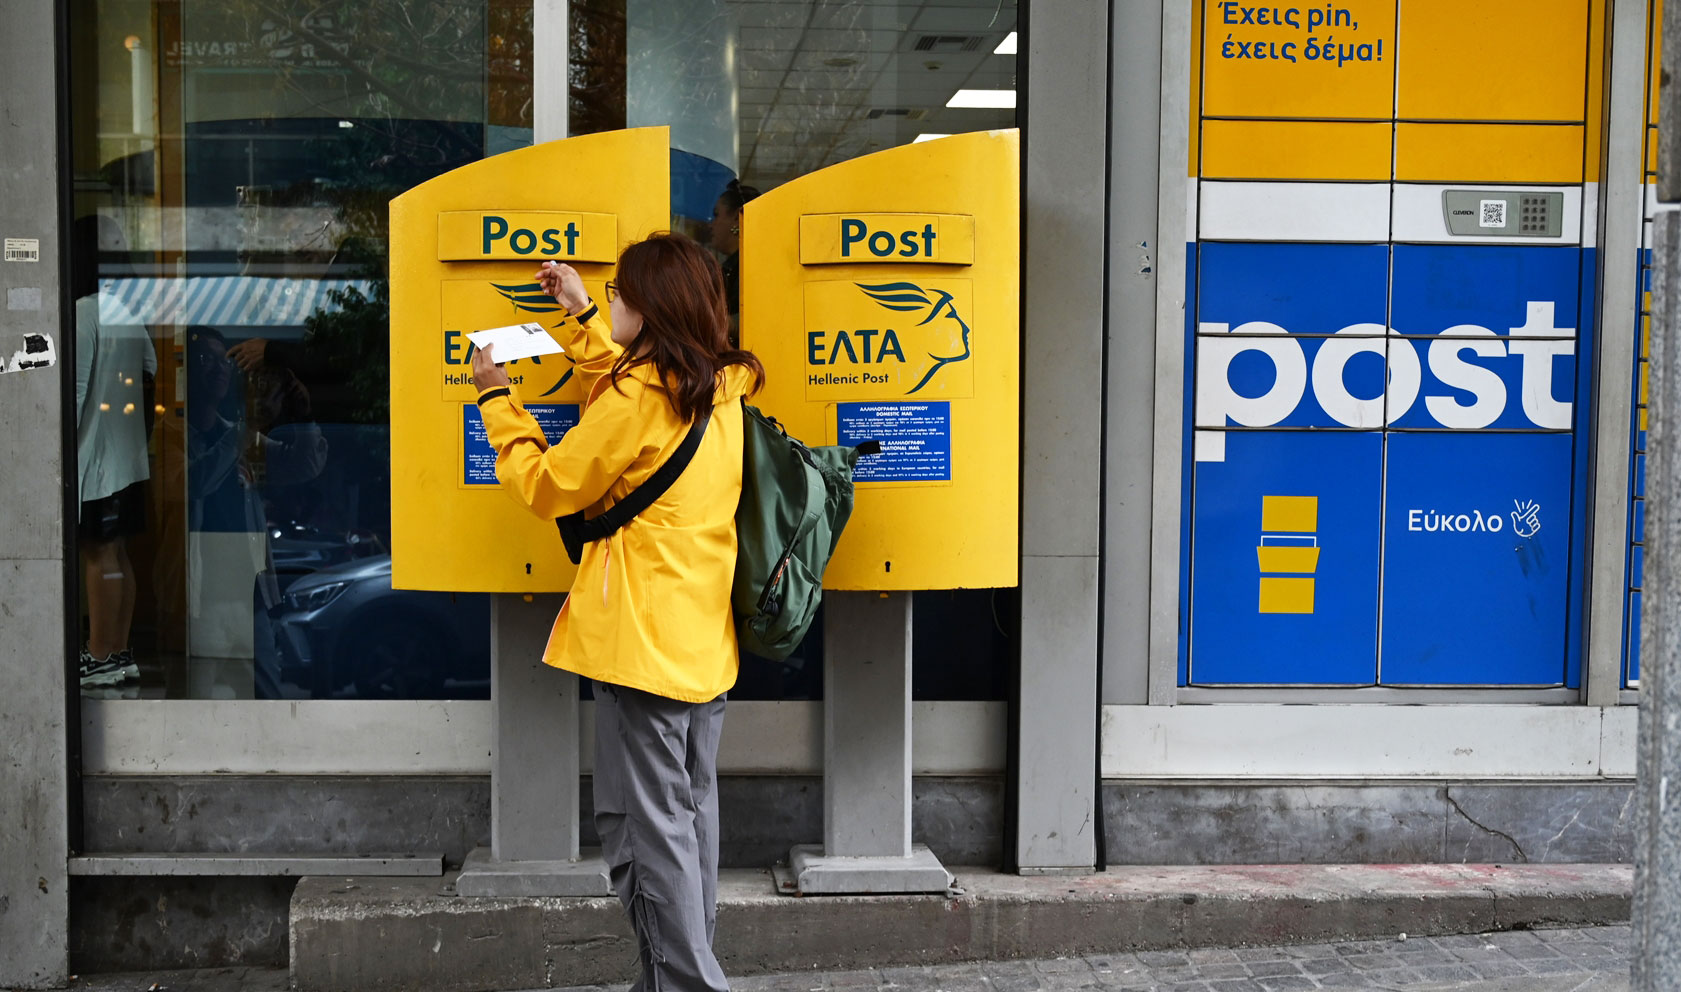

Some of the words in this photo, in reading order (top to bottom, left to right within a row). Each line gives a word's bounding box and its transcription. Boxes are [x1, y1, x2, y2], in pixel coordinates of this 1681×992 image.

[1218, 1, 1300, 29] Έχεις
[1307, 3, 1359, 33] pin,
[1221, 33, 1297, 63] έχεις
[1304, 36, 1383, 68] δέμα!
[482, 215, 580, 256] Post
[841, 219, 936, 257] Post
[808, 329, 906, 365] ΕΛΤΑ
[444, 374, 474, 386] Helle
[808, 373, 859, 386] Hellenic
[863, 372, 890, 384] Post
[1195, 301, 1576, 462] post
[1407, 508, 1504, 533] Εύκολο
